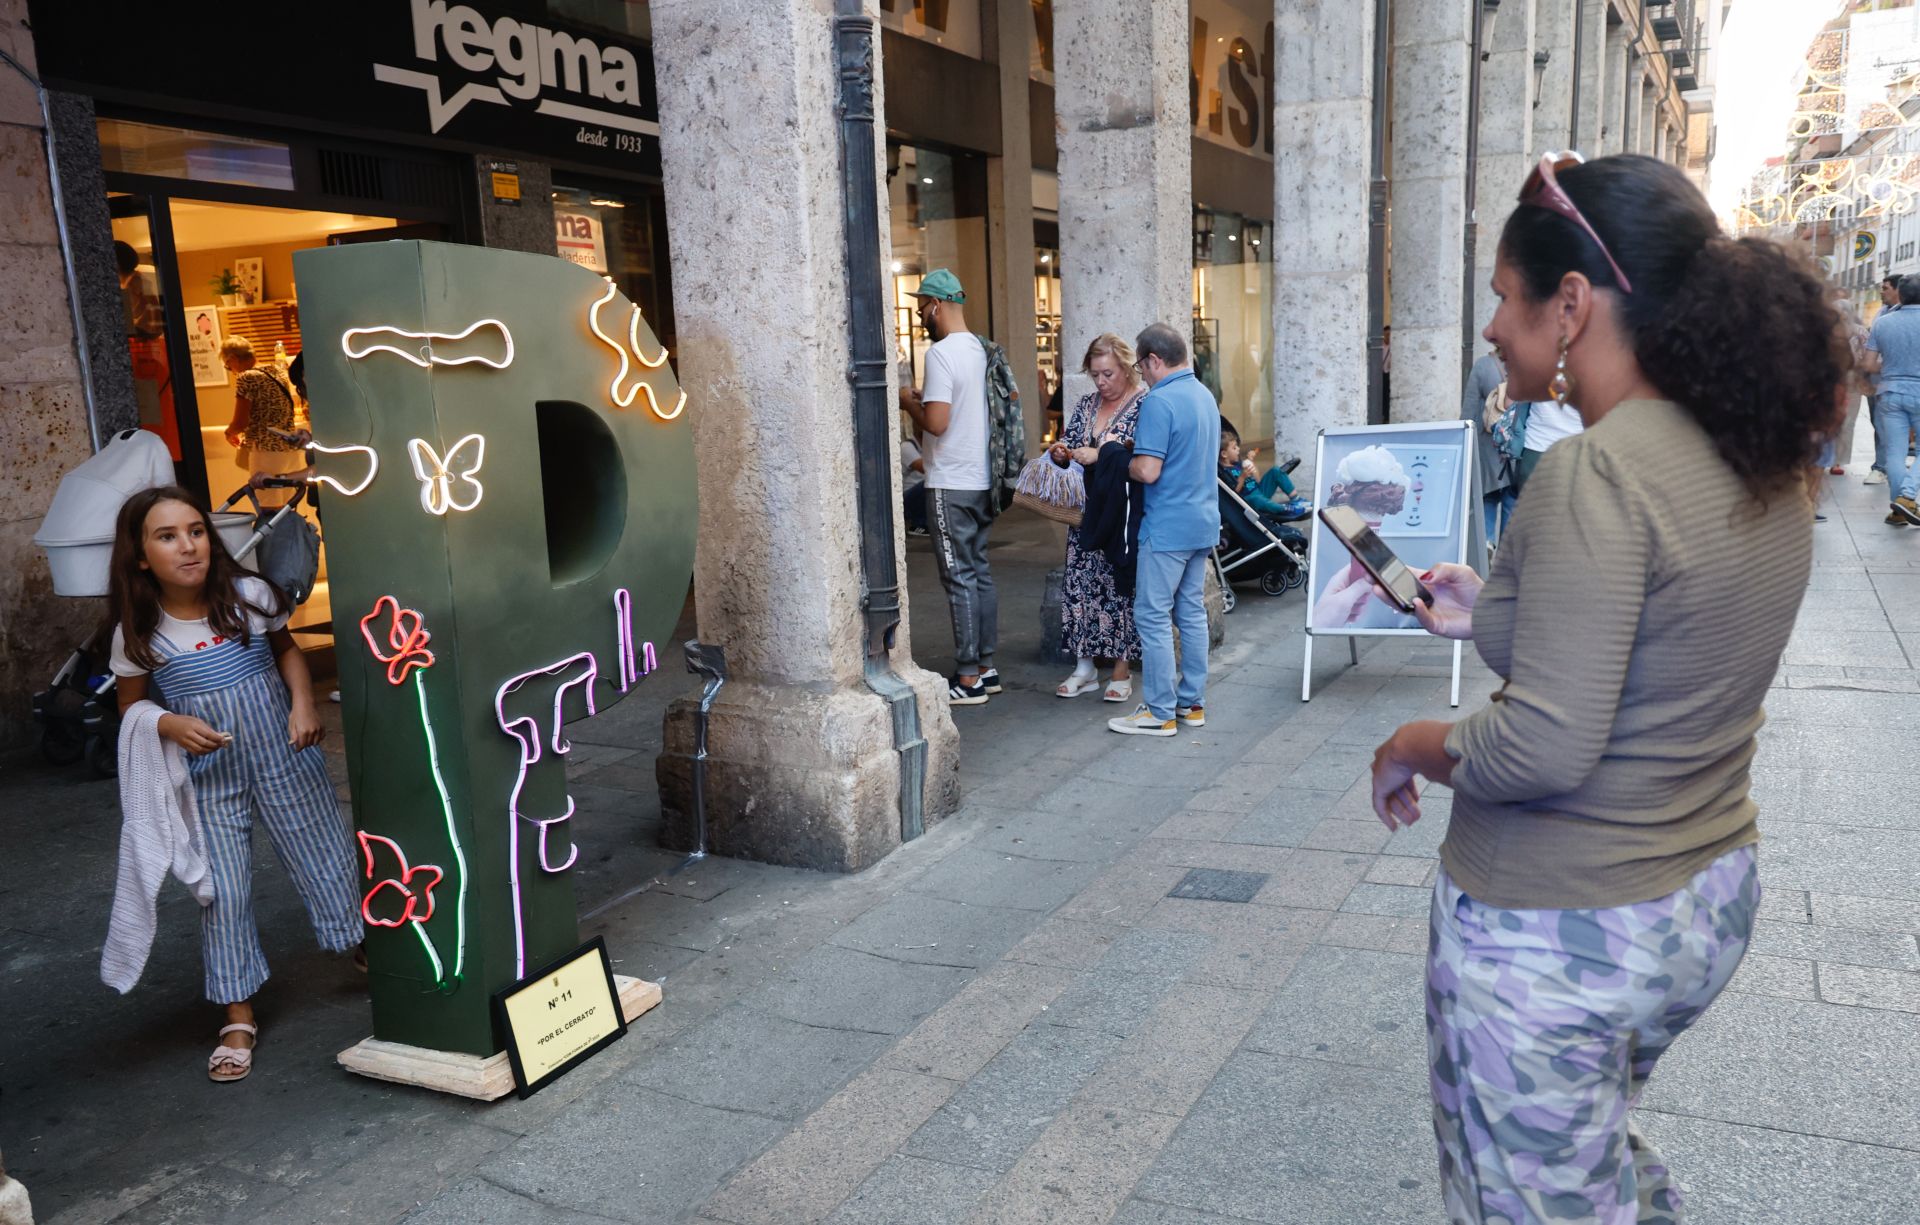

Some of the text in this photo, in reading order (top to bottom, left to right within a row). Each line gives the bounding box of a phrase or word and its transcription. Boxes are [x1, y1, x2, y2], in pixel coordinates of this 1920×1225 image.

[411, 0, 642, 107] regma
[576, 126, 642, 153] desde 1933
[936, 504, 946, 534] YOUR
[943, 535, 954, 569] TRUST
[561, 989, 572, 1002] 11
[555, 1027, 564, 1036] EL
